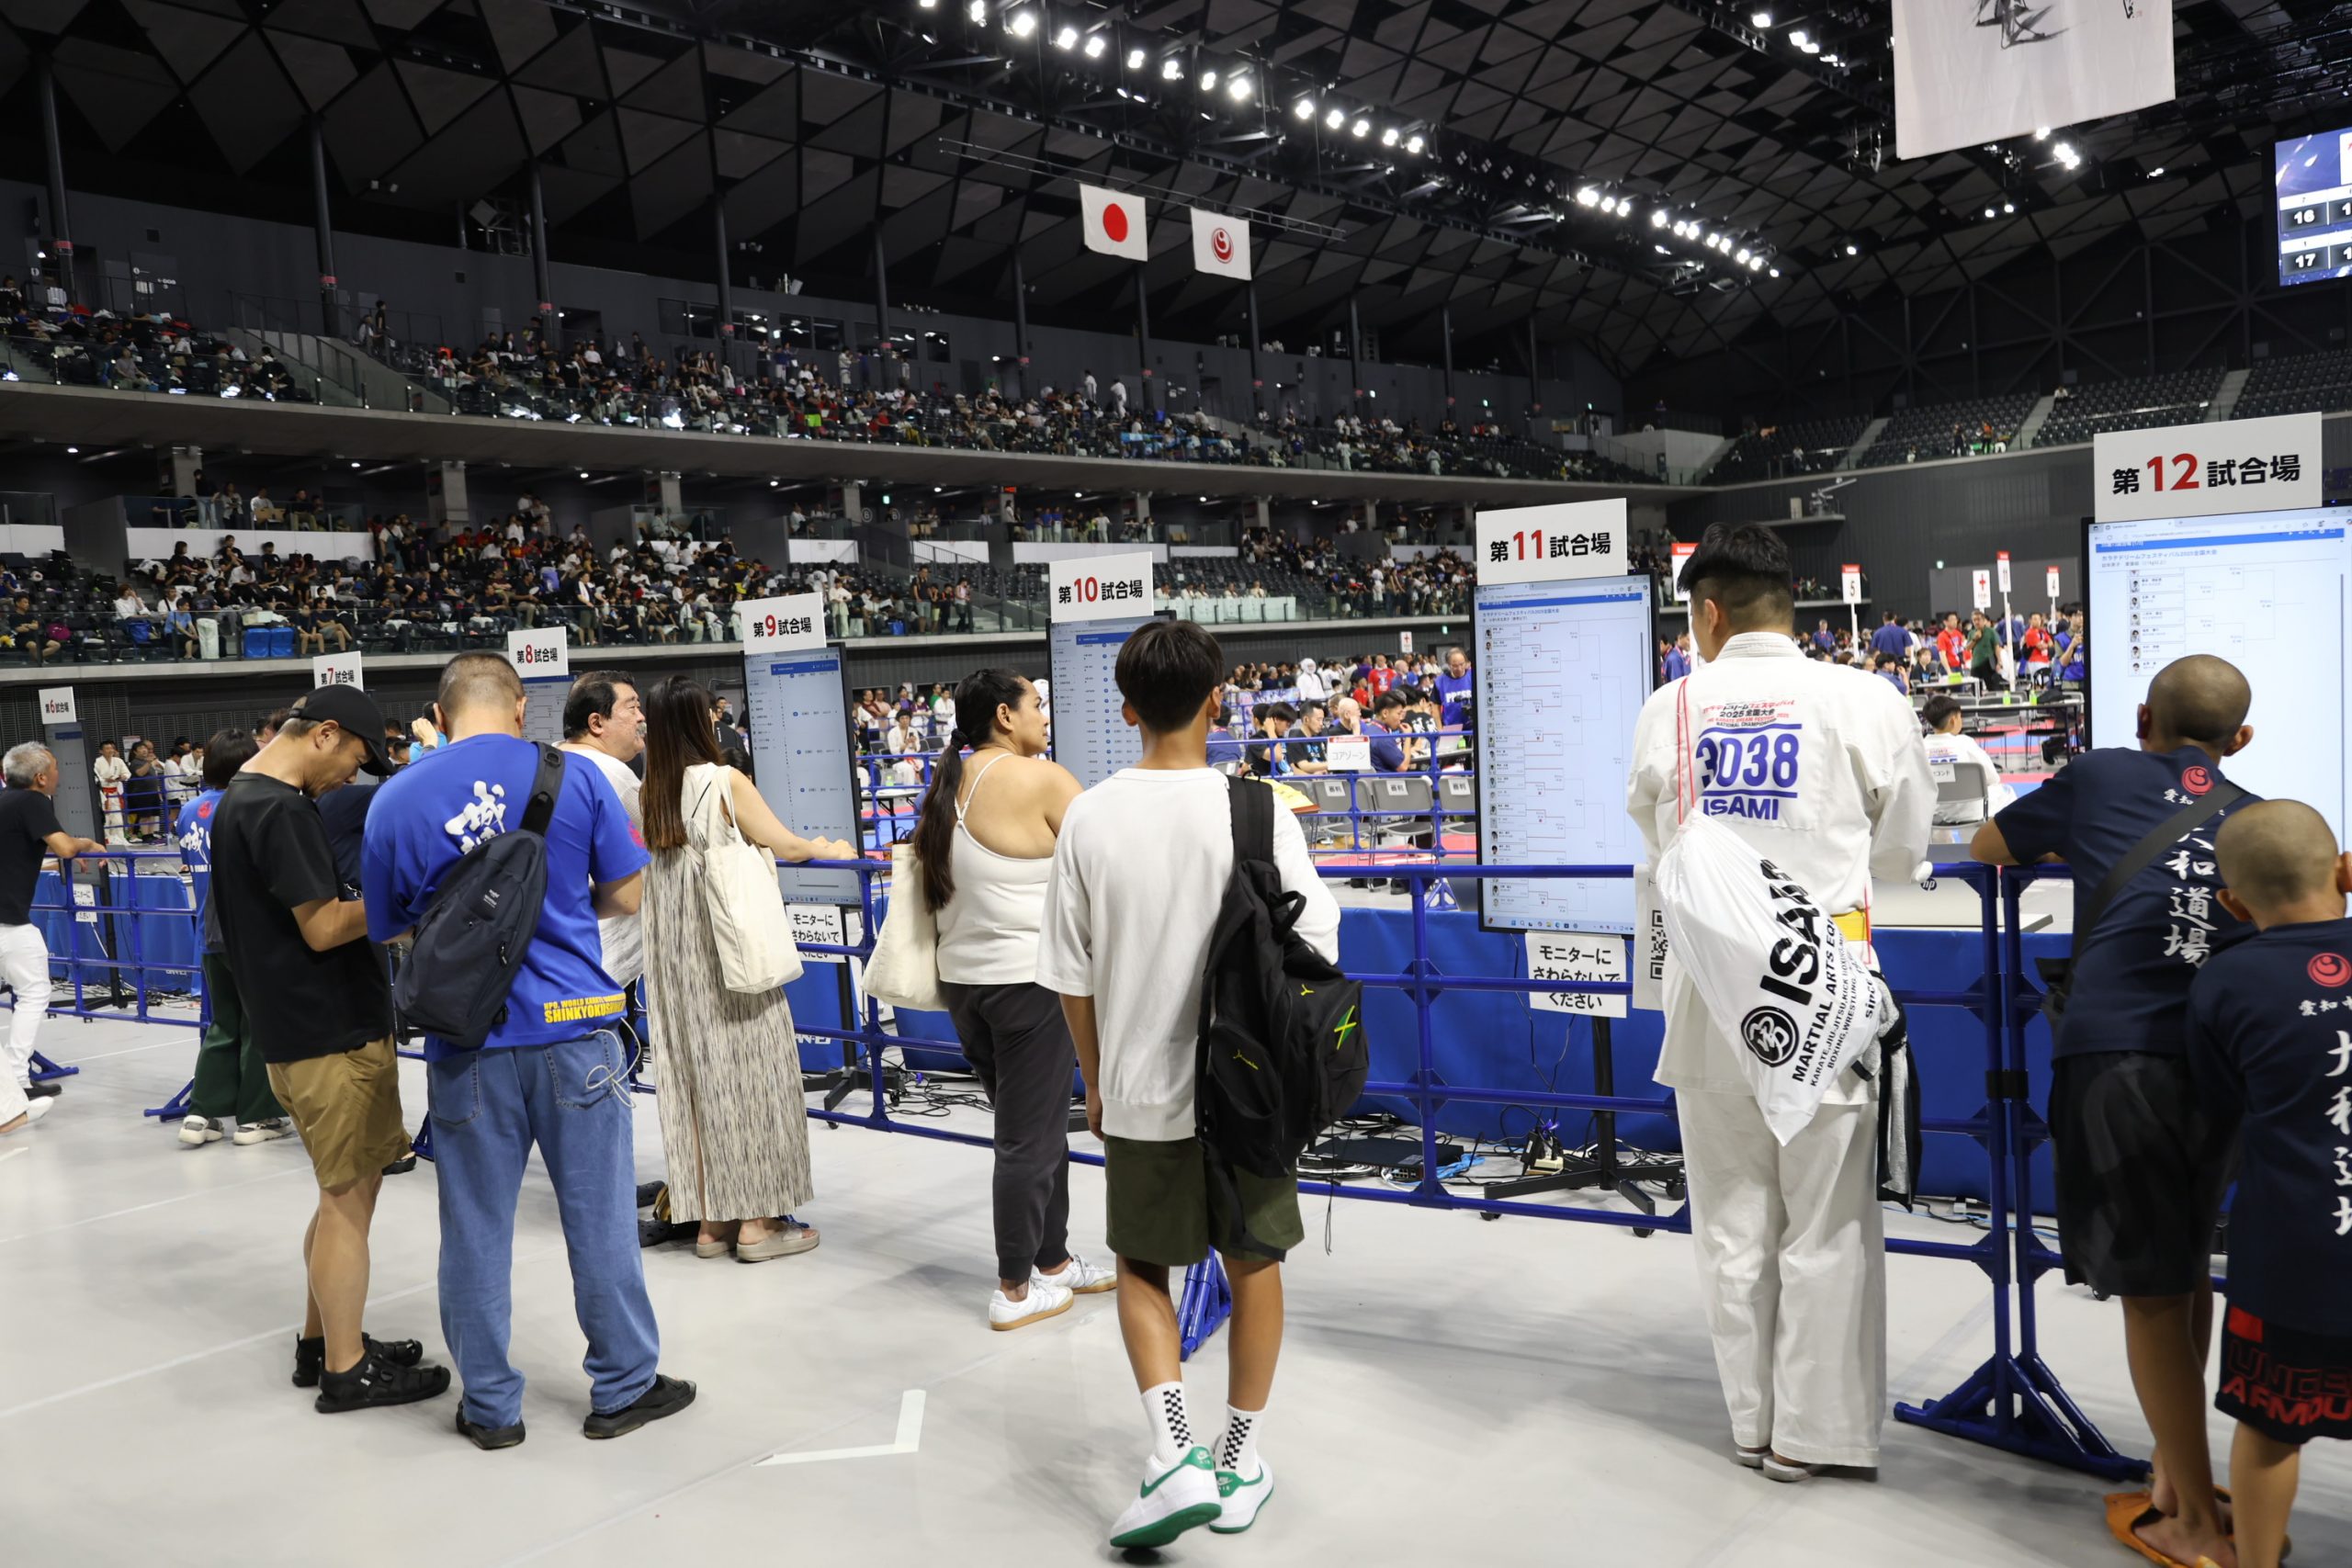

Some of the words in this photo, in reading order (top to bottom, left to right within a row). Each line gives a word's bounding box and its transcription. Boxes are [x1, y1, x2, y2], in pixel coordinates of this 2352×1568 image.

[2294, 209, 2315, 224] 16
[2295, 253, 2316, 268] 17
[2111, 453, 2301, 494] 第12試合場
[1490, 529, 1611, 563] 第11試合場
[1058, 576, 1143, 604] 第10試合場
[1849, 581, 1856, 597] 5
[753, 615, 812, 637] 第9試合場
[516, 644, 558, 664] 第8試合場
[321, 667, 355, 685] 第7試合場
[45, 700, 70, 714] 第6試合場
[1696, 733, 1799, 788] 3038
[1702, 795, 1779, 820] ISAMI
[793, 913, 833, 926] モニターに
[1540, 944, 1611, 964] モニターに
[561, 998, 584, 1008] WORLD
[1549, 992, 1602, 1010] ください
[1792, 1000, 1834, 1082] MARTIAL
[1825, 952, 1838, 997] ARTS
